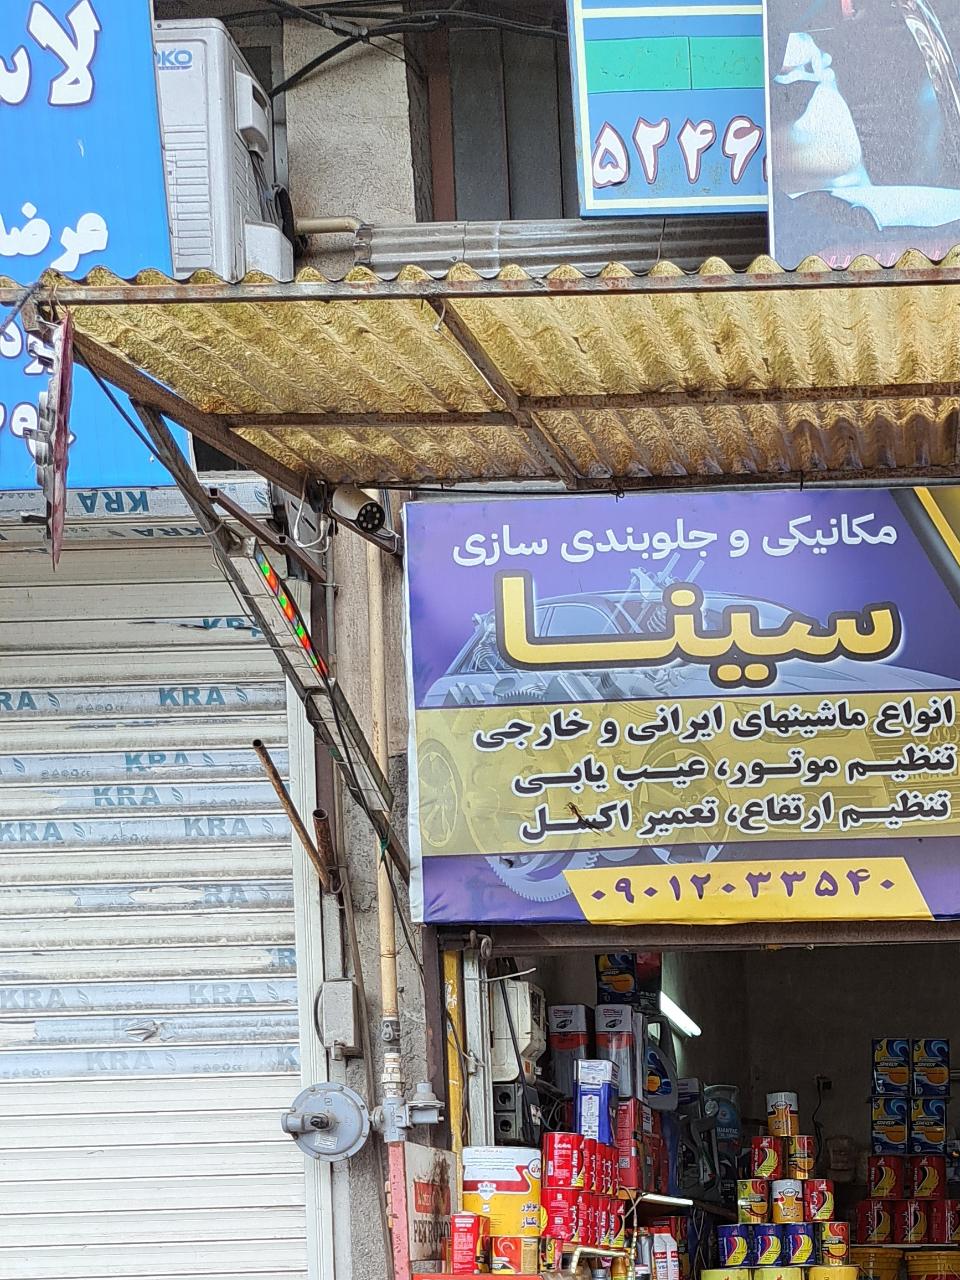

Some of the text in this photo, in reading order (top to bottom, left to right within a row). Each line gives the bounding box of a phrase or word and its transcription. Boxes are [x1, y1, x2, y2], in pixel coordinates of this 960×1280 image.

[592, 116, 768, 188] ۵۲۴۶
[453, 514, 897, 566] مکانیکی و جلوبندی سازی
[497, 572, 898, 685] سینا
[158, 687, 227, 707] KRA
[475, 697, 955, 751] انواع ماشینهای ایرانی و خارجی
[514, 755, 605, 795] یابی
[616, 759, 707, 790] عیب
[717, 752, 837, 788] موتور،
[845, 746, 957, 786] تنظیم
[94, 785, 162, 806] KRA
[184, 817, 250, 838] KRA
[520, 791, 950, 843] تنظیم ارتفاع، تعمیر اکسل
[591, 868, 896, 904] ۰۹۰۱۲۰۳۳۵۴۰
[1, 983, 257, 1009] KRA KRA
[87, 1051, 155, 1071] KRA
